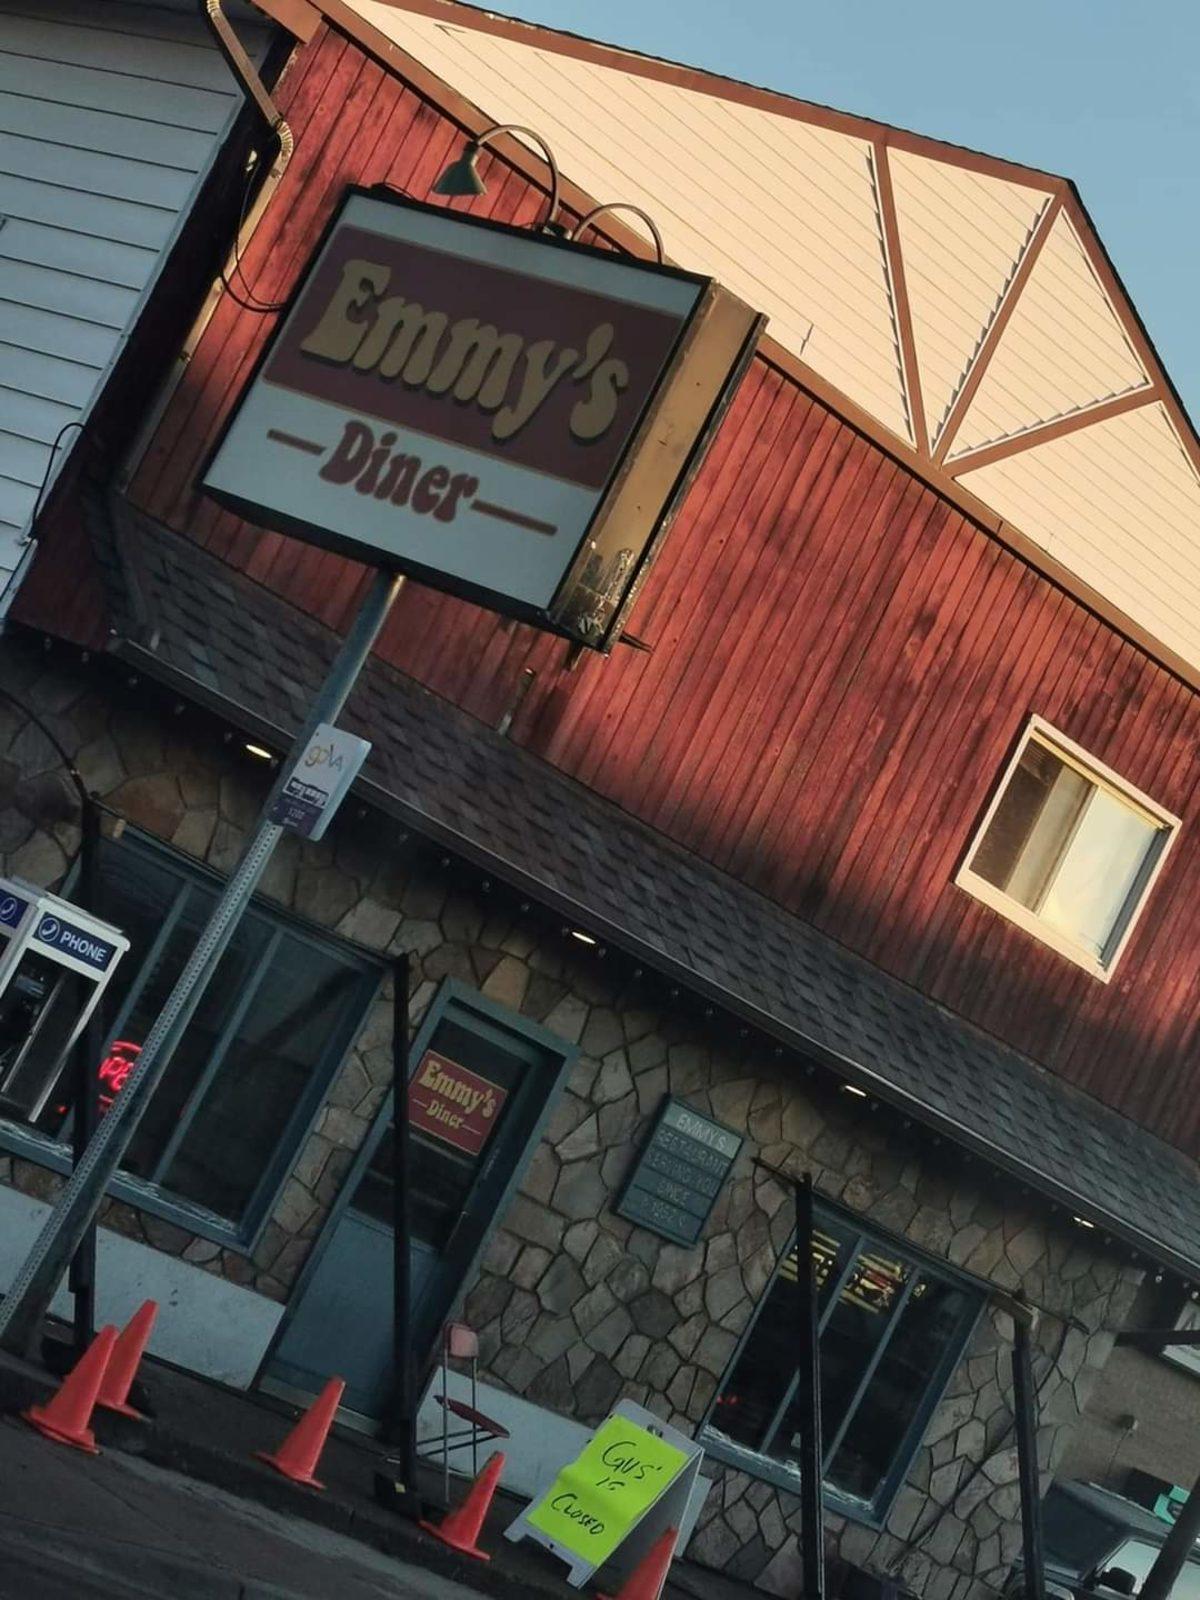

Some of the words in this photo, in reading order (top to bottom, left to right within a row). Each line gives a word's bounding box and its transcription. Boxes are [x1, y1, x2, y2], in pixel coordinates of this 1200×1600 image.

[300, 258, 629, 440] Emmy's
[319, 420, 479, 522] Diner
[60, 931, 107, 962] PHONE
[418, 1060, 497, 1119] Emmy's
[426, 1100, 465, 1129] Diner
[551, 1492, 605, 1535] CLOSED
